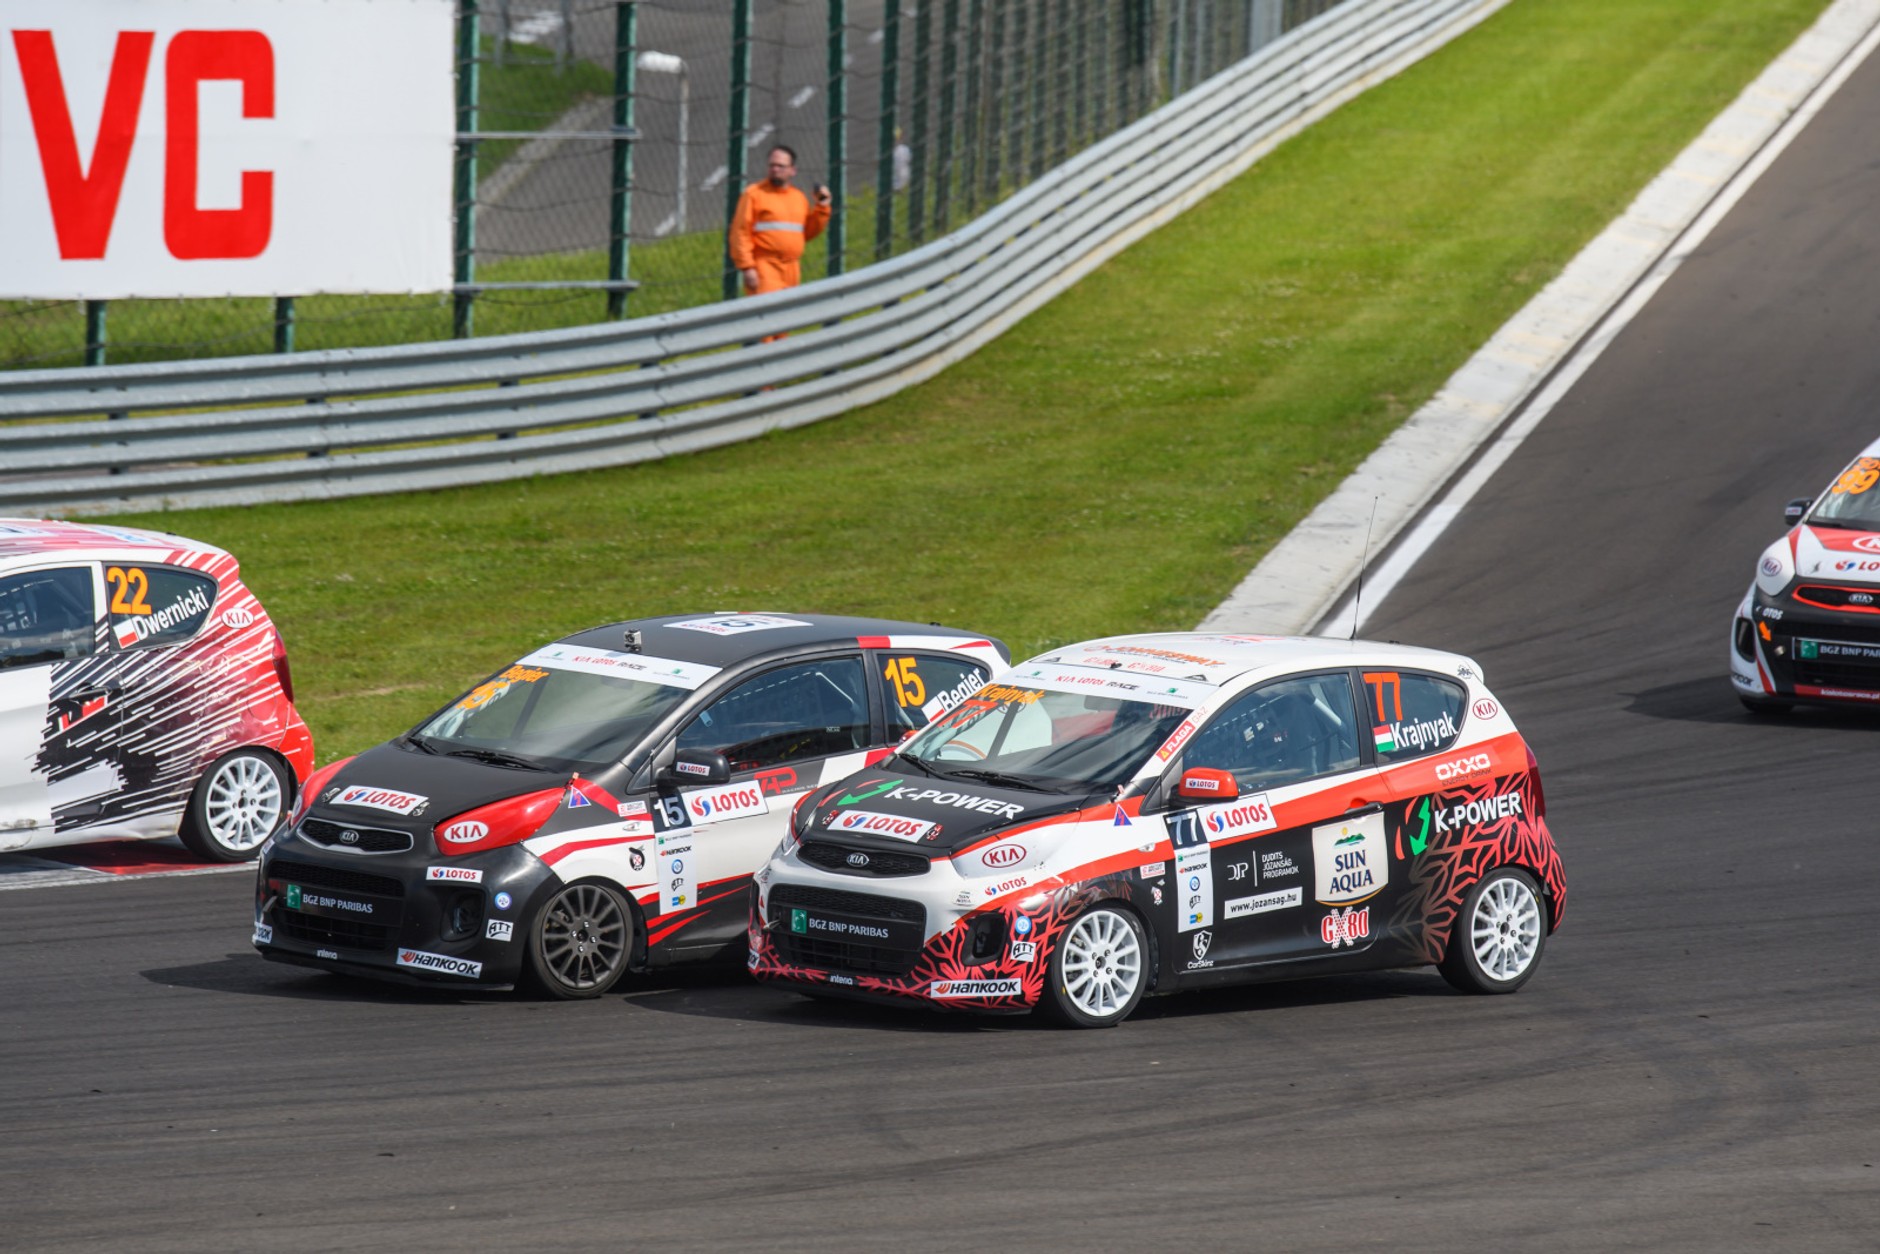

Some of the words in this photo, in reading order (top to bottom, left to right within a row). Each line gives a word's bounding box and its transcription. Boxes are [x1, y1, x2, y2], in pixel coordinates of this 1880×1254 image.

[12, 29, 275, 261] VC
[1831, 469, 1880, 495] 99
[106, 566, 152, 616] 22
[133, 586, 209, 640] Dwernicki
[225, 611, 251, 625] KIA
[884, 656, 927, 708] 15
[1055, 674, 1075, 683] KIA
[1076, 676, 1105, 686] LOTOS
[1106, 681, 1139, 691] RACE
[1363, 671, 1404, 722] 77
[1475, 701, 1496, 717] KIA
[1166, 724, 1193, 752] FLAGA
[1389, 711, 1457, 750] Krajnyak
[687, 765, 707, 774] LOTOS
[1435, 753, 1491, 780] OXXO
[1196, 780, 1216, 789] LOTOS
[361, 790, 417, 809] LOTOS
[711, 788, 760, 813] LOTOS
[884, 786, 1025, 820] K-POWER
[653, 796, 685, 828] 15
[1224, 803, 1268, 828] LOTOS
[1434, 791, 1523, 834] K-POWER
[342, 831, 355, 842] KIA
[450, 824, 483, 840] KIA
[863, 815, 923, 836] LOTOS
[1165, 810, 1199, 845] 77
[849, 854, 865, 865] KIA
[988, 847, 1020, 865] KIA
[1334, 849, 1367, 873] SUN
[445, 869, 476, 880] LOTOS
[997, 876, 1027, 892] LOTOS
[1329, 869, 1374, 895] AQUA
[319, 896, 337, 908] BNP
[337, 899, 374, 914] PARIBAS
[1230, 893, 1297, 913] www.jozansag.hu
[488, 922, 512, 935] ATT
[828, 921, 847, 934] BNP
[848, 924, 889, 938] PARIBAS
[1321, 906, 1370, 949] CX80
[1013, 942, 1034, 956] ATT
